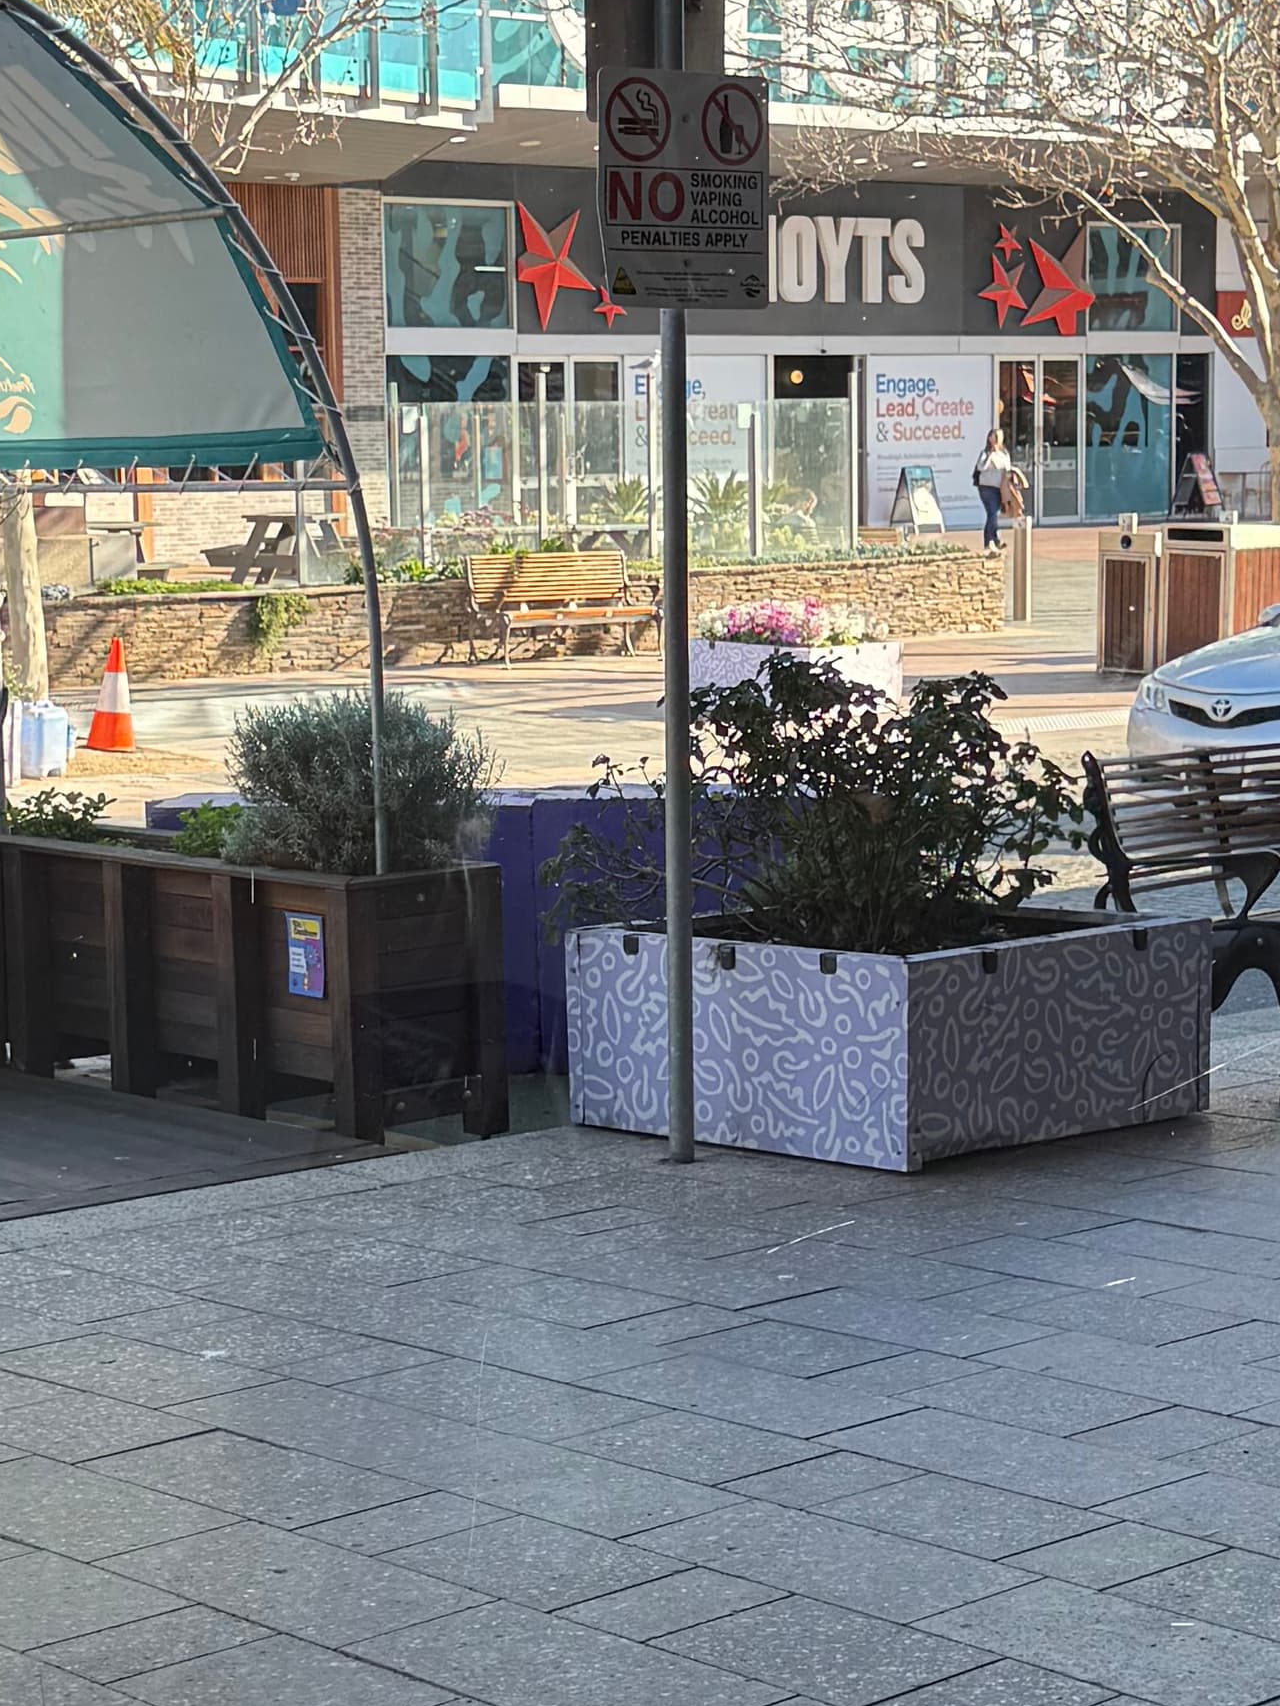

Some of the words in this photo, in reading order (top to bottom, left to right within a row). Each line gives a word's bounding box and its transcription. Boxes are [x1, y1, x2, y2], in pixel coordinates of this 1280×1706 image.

[608, 170, 685, 222] NO
[690, 173, 758, 190] SMOKING
[690, 191, 742, 207] VAPING
[690, 209, 759, 225] ALCOHOL
[621, 230, 700, 247] PENALTIES
[705, 233, 748, 248] APPLY
[876, 373, 939, 398] Engage,
[876, 397, 919, 419] Lead,
[922, 397, 974, 417] Create
[876, 421, 888, 442] &
[893, 420, 965, 441] Succeed.
